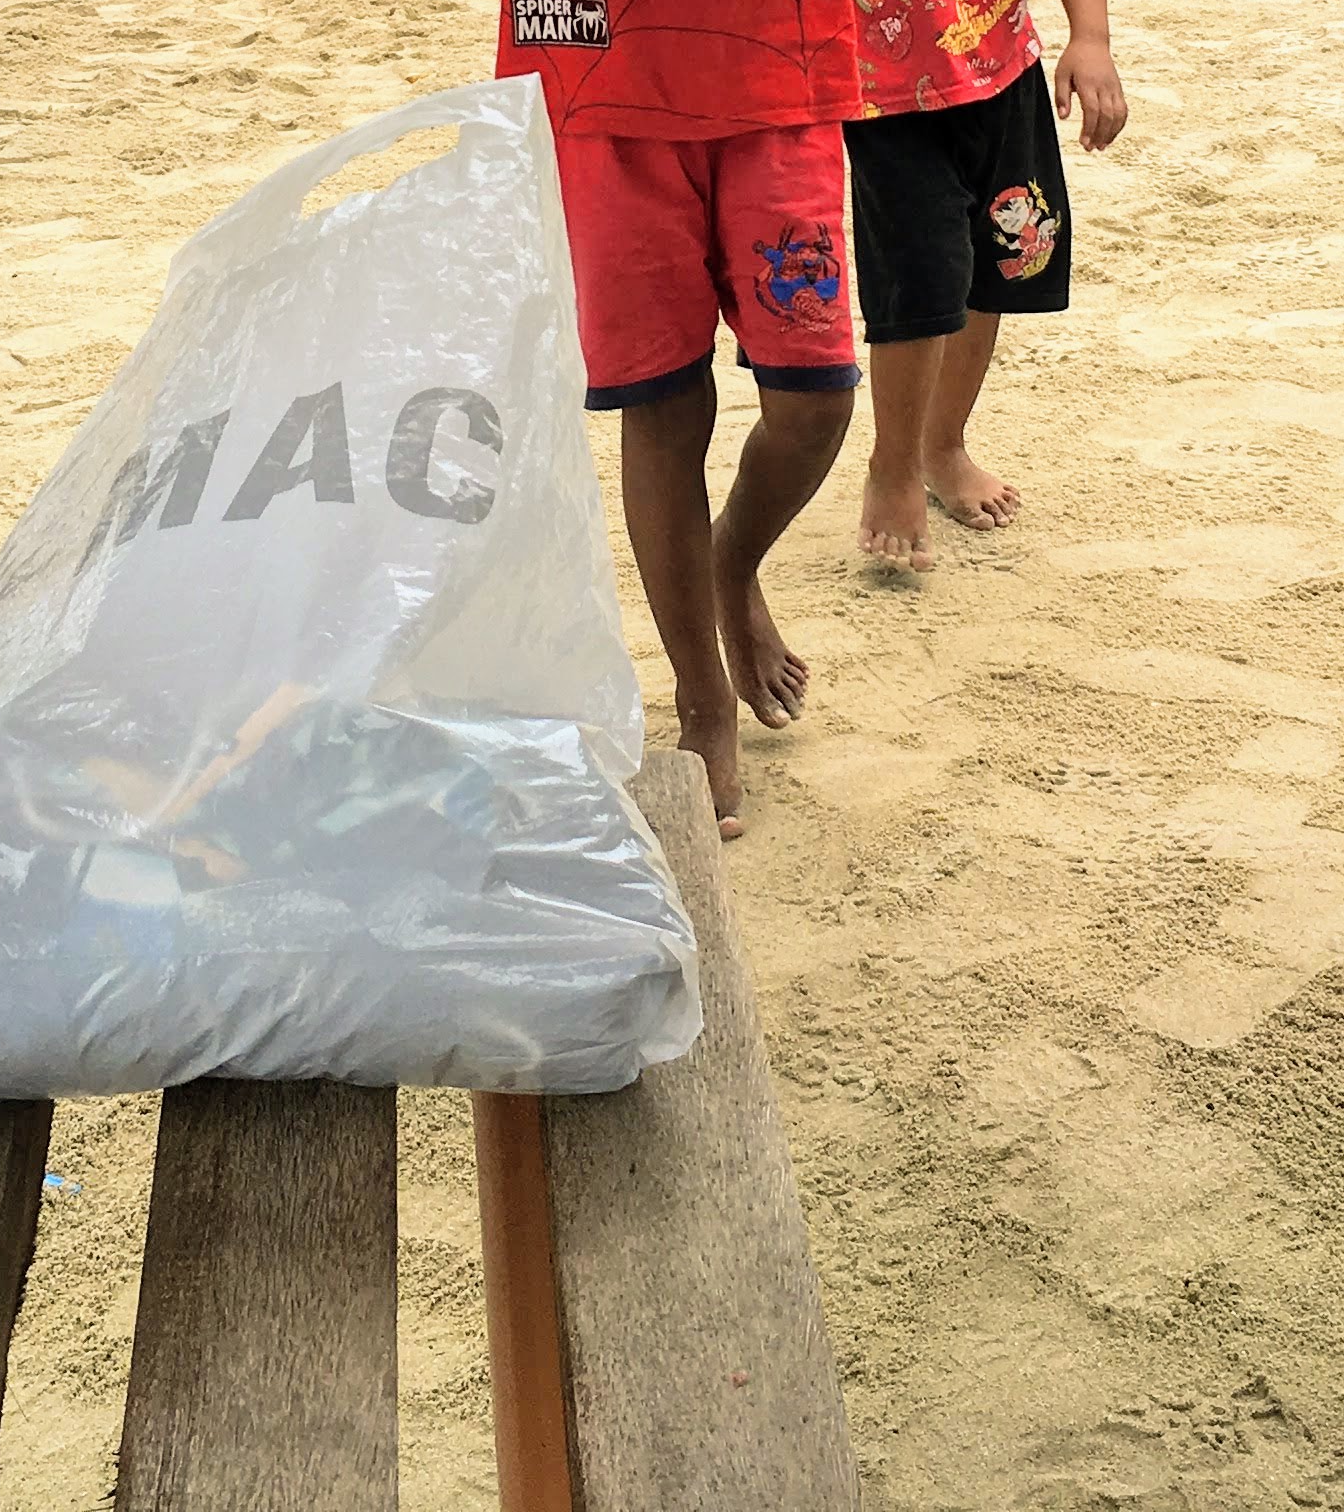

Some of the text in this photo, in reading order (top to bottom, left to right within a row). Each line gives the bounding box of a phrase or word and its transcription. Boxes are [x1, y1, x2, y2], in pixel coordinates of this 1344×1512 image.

[516, 0, 572, 16] SPIDER
[518, 15, 572, 41] MAN
[74, 381, 504, 578] MAC
